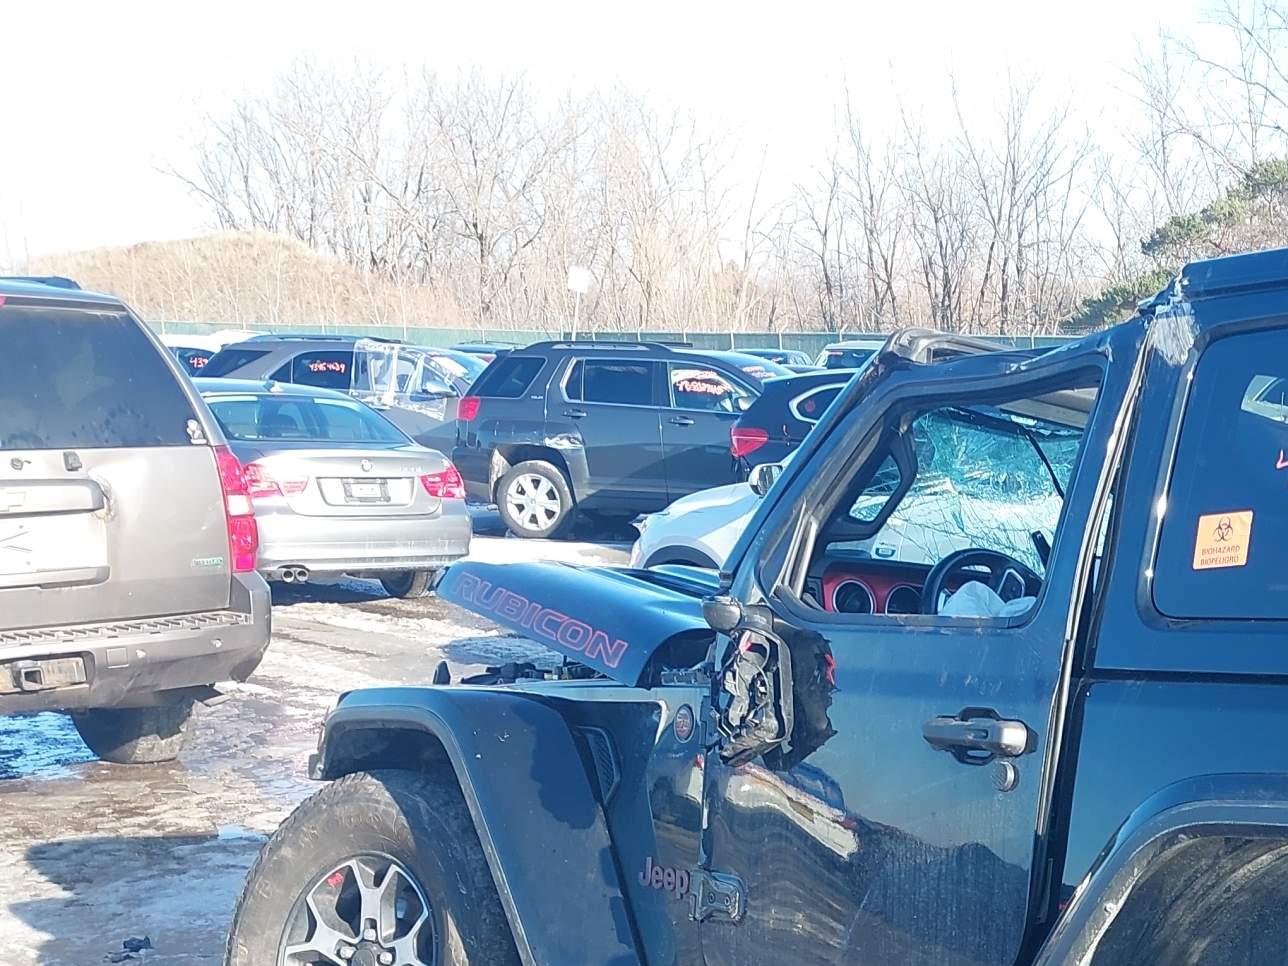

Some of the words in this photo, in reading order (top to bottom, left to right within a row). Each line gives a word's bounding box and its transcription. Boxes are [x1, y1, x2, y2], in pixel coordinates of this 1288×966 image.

[1201, 545, 1240, 556] BIOHAZARD
[455, 572, 629, 669] RUBICON
[638, 856, 690, 900] Jeep
